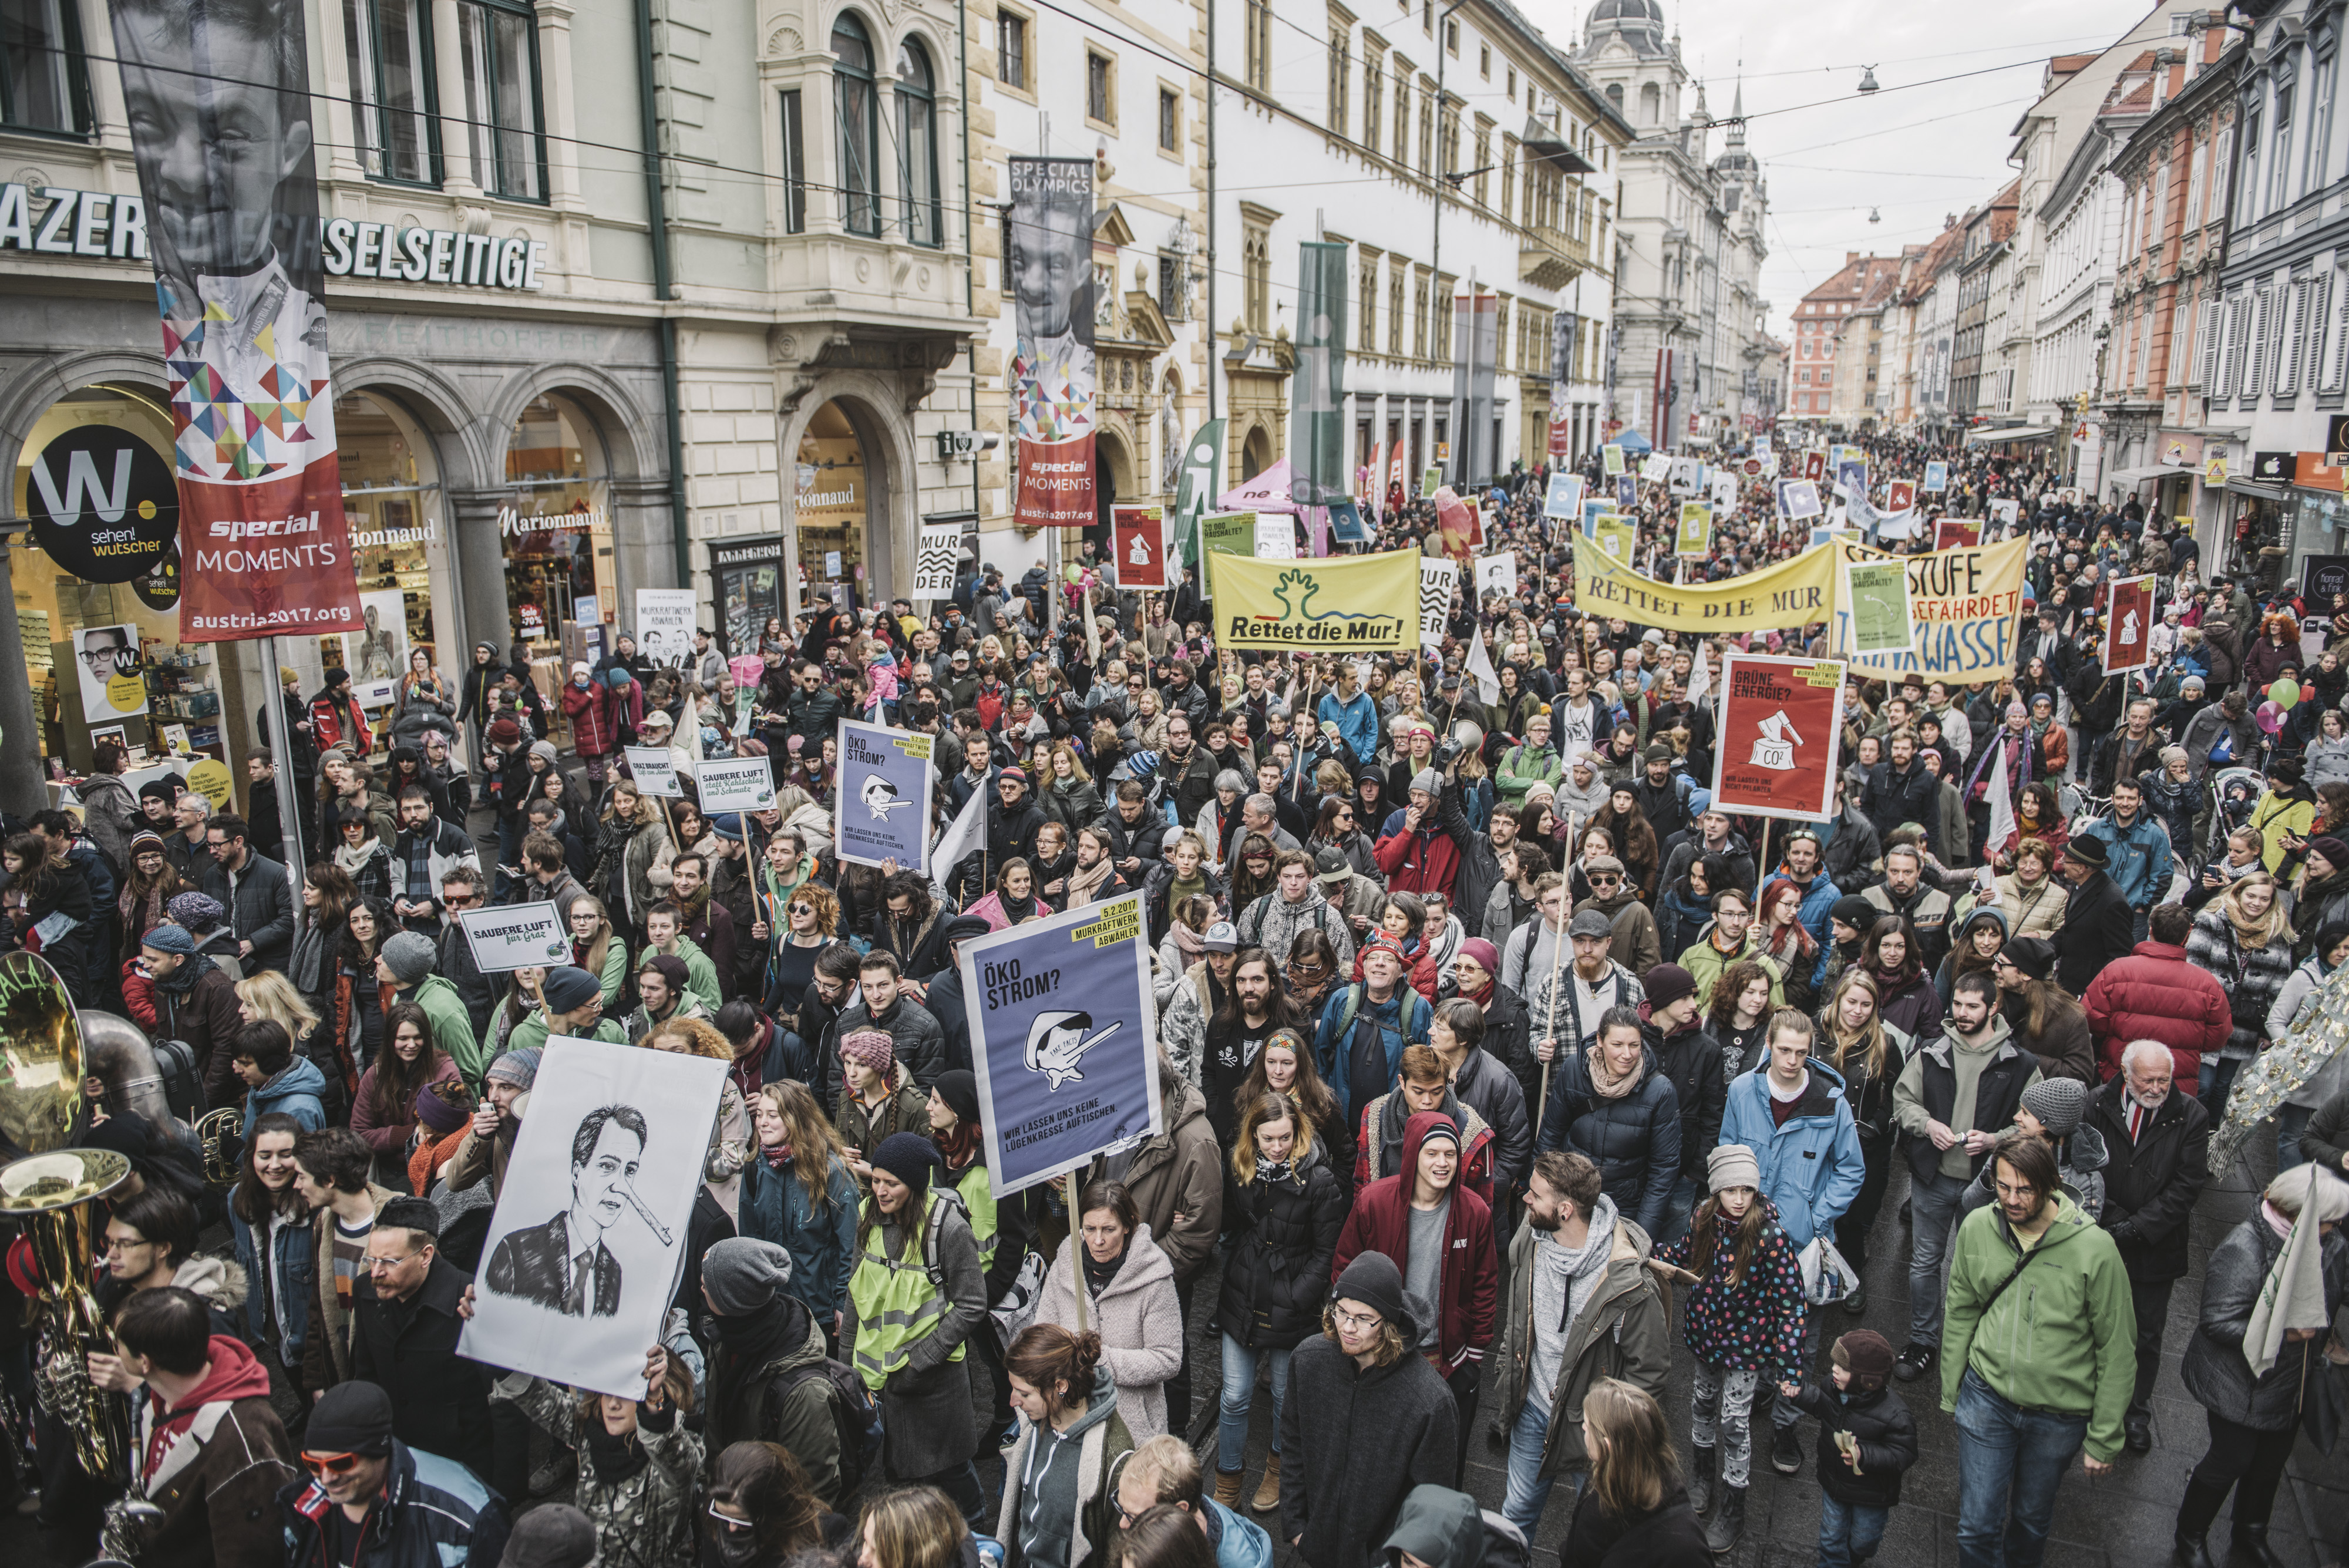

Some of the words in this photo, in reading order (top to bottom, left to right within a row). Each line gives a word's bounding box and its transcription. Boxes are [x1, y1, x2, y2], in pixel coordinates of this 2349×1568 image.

[1012, 161, 1089, 179] SPECIAL
[1012, 177, 1090, 194] OLYMPICS
[364, 321, 600, 352] REITHOFFER
[1031, 460, 1087, 475] special
[1024, 475, 1091, 491] MOMENTS
[497, 504, 605, 538] Marionnaud
[1021, 509, 1093, 520] austria2017.org
[208, 510, 319, 542] special
[1116, 520, 1143, 529] ENERGIE?
[91, 527, 136, 545] sehen!
[1204, 527, 1243, 539] HAUSHALTE?
[92, 540, 161, 557] wutscher
[920, 535, 958, 549] MUR
[196, 543, 336, 573] MOMENTS
[719, 544, 781, 563] ANNENHOF
[149, 578, 167, 588] sehen!
[915, 575, 953, 590] DER
[1853, 578, 1893, 588] HAUSHALTE?
[2320, 573, 2344, 583] Konrad
[149, 587, 177, 596] wutscher
[2327, 583, 2342, 593] Fink
[1587, 575, 1684, 617] RETTET
[1702, 597, 1755, 618] DIE
[1771, 586, 1823, 613] MUR
[191, 605, 351, 629] austria2017.org
[521, 608, 537, 617] Sale
[641, 606, 693, 615] MURKRAFTWERK
[1230, 616, 1304, 640] Rettet
[1307, 621, 1342, 641] die
[1347, 620, 1404, 640] Mur!
[1420, 615, 1443, 634] ER
[1735, 669, 1775, 687] GRÜNE
[1796, 669, 1840, 679] MURKRAFTWERK
[1810, 679, 1839, 688] ABWÄHLEN
[1734, 684, 1792, 701] ENERGIE?
[847, 734, 866, 751] ÖKO
[895, 740, 930, 752] MURKRAFTWERK
[911, 736, 930, 745] 5.2.2017
[847, 748, 886, 767] STROM?
[906, 749, 930, 759] ABWÄHLEN
[191, 772, 210, 780] Ray-Ban
[191, 777, 216, 787] Fassungen
[702, 772, 742, 782] SAUBERE
[742, 769, 764, 777] LUFT
[705, 780, 723, 789] statt
[723, 776, 765, 788] Kahlschlag
[1736, 776, 1759, 785] LASSEN
[720, 786, 752, 796] Schmutz
[1725, 783, 1741, 791] NICHT
[1742, 785, 1772, 793] PFLANZEN
[844, 832, 876, 844] LÜGENKRESSE
[876, 838, 905, 850] AUFTISCHEN.
[854, 827, 872, 836] LASSEN
[872, 830, 882, 838] UNS
[882, 832, 896, 842] KEINE
[1103, 900, 1137, 918] 5.2.2017
[473, 924, 524, 940] SAUBERE
[524, 919, 553, 932] LUFT
[1075, 912, 1139, 940] MURKRAFTWERK
[505, 933, 523, 945] für
[523, 930, 547, 943] Graz
[1098, 925, 1140, 947] ABWÄHLEN
[984, 958, 1021, 988] ÖKO
[987, 969, 1061, 1011] STROM?
[1049, 1044, 1063, 1057] FAKE
[1063, 1036, 1078, 1048] FACTS
[1004, 1128, 1021, 1141] WIR
[1022, 1113, 1055, 1134] LASSEN
[1056, 1107, 1073, 1122] UNS
[1075, 1097, 1100, 1115] KEINE
[1005, 1125, 1064, 1153] LÜGENKRESSE
[1066, 1103, 1118, 1130] AUFTISCHEN.
